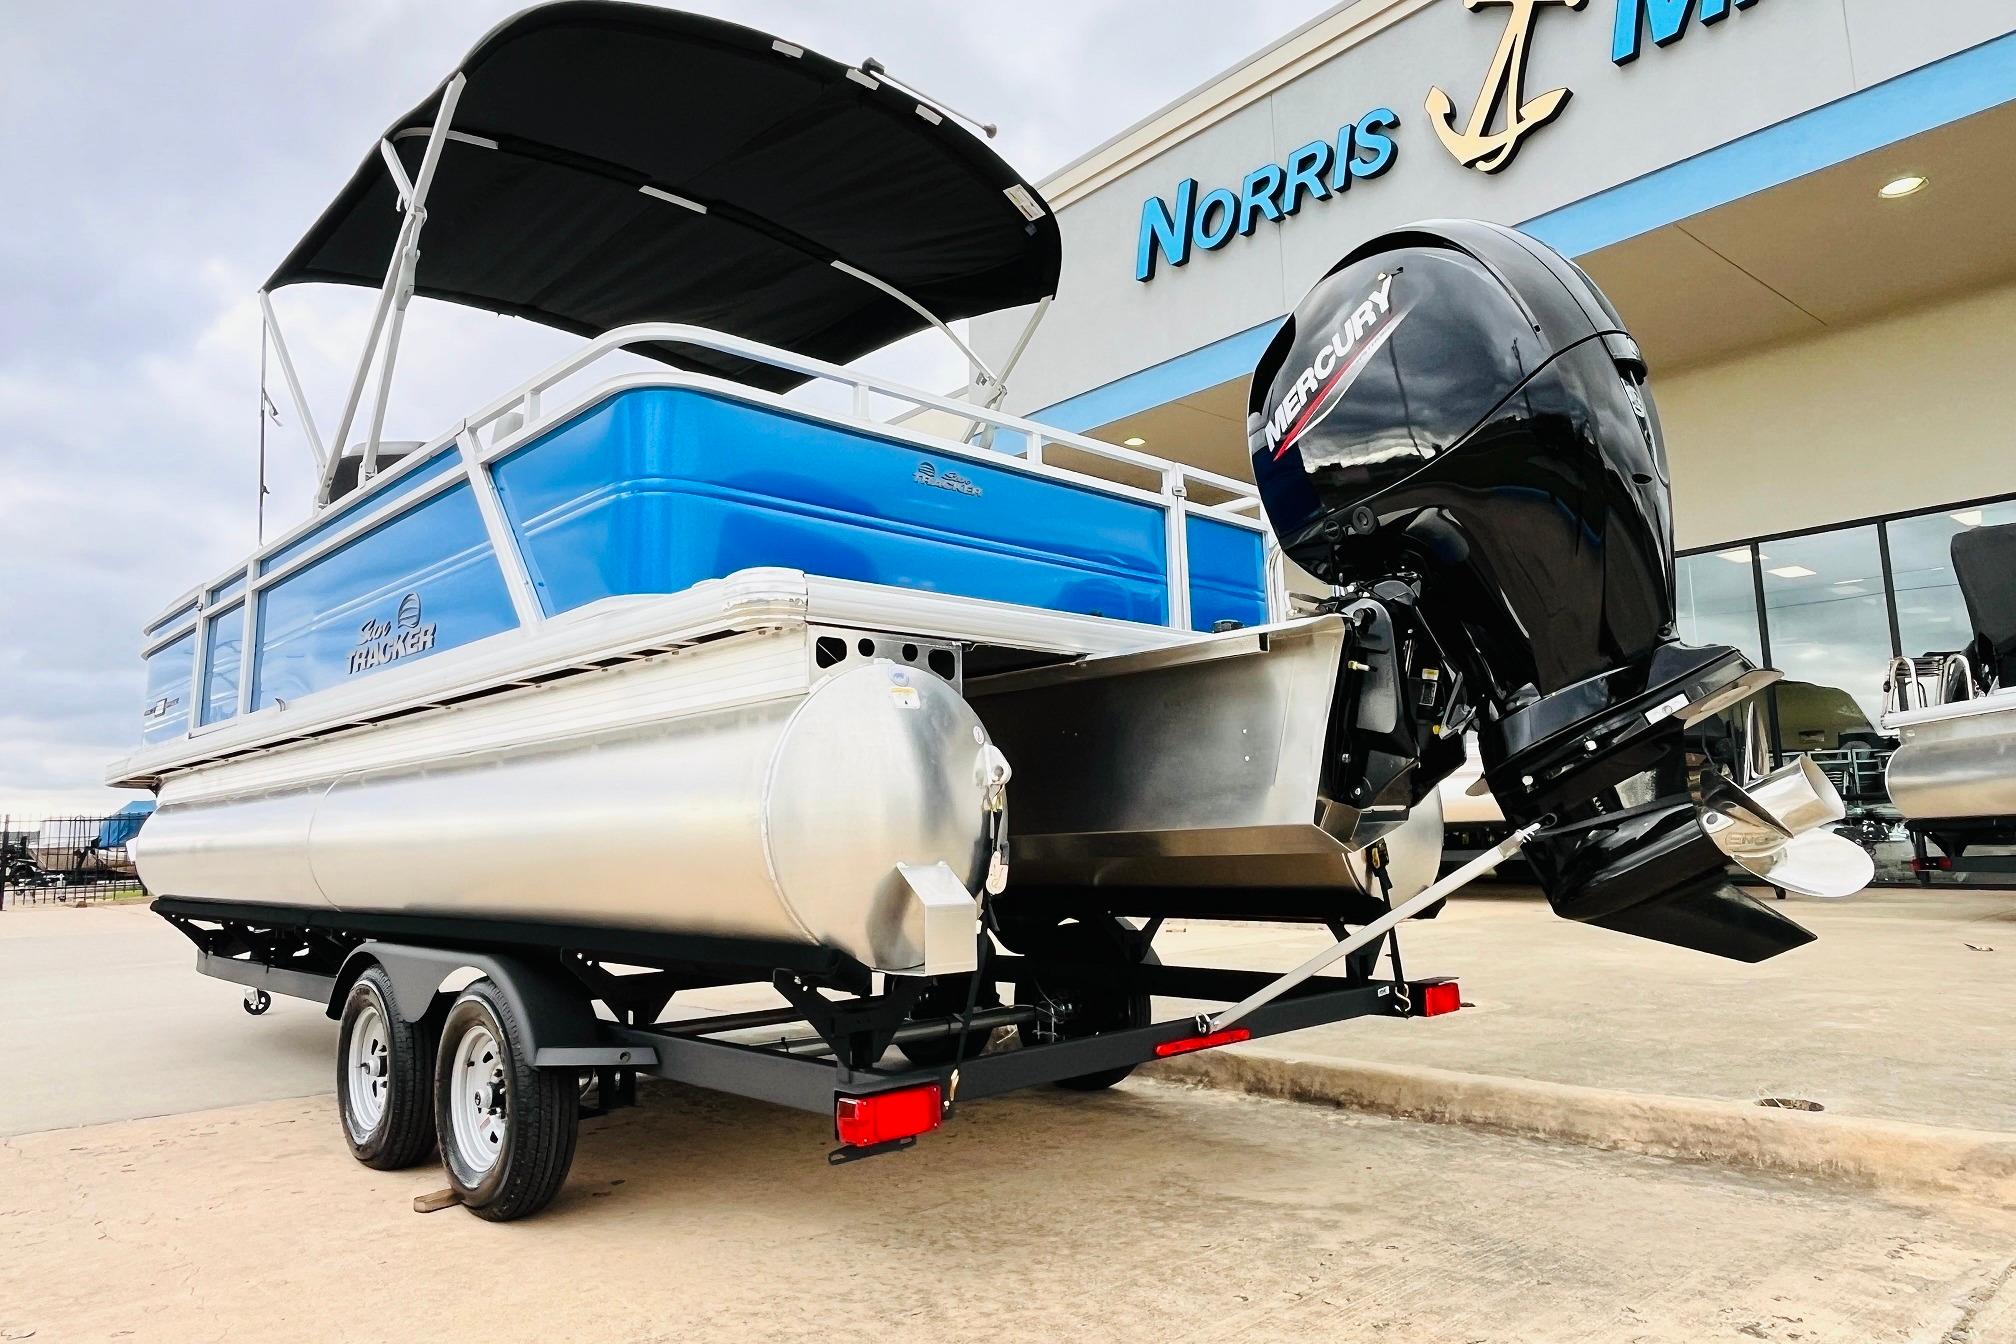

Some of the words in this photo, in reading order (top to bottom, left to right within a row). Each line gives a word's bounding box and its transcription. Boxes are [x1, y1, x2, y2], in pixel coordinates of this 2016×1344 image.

[1136, 107, 1400, 282] NORRIS
[1264, 273, 1393, 452] MERCURY
[346, 622, 437, 674] TRACKER
